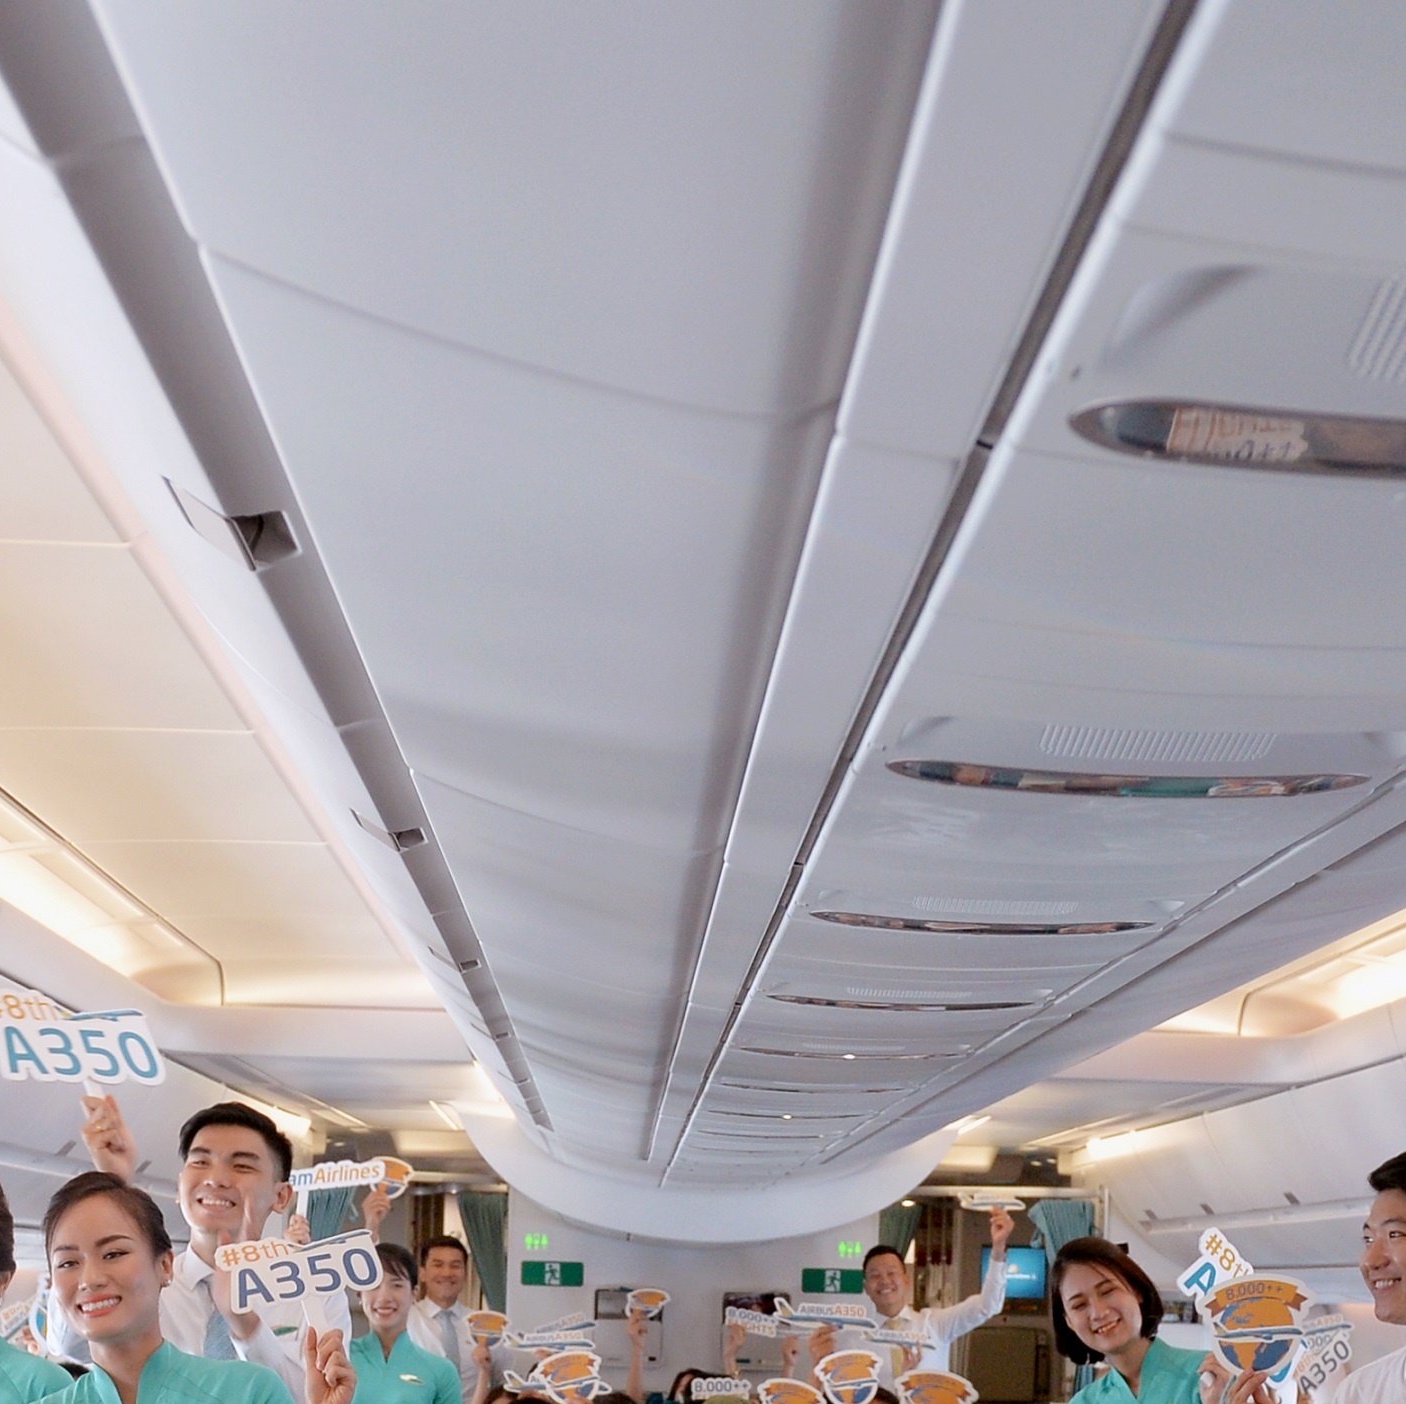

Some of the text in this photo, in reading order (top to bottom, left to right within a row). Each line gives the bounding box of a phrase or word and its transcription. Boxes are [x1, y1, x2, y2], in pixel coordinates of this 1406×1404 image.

[4, 1026, 158, 1079] A350
[289, 1164, 380, 1187] amAirlines
[222, 1240, 290, 1267] #8th
[238, 1249, 378, 1309] A350
[1225, 1282, 1284, 1301] 8.000++
[1300, 1340, 1350, 1395] A350
[695, 1380, 748, 1392] 8.000++
